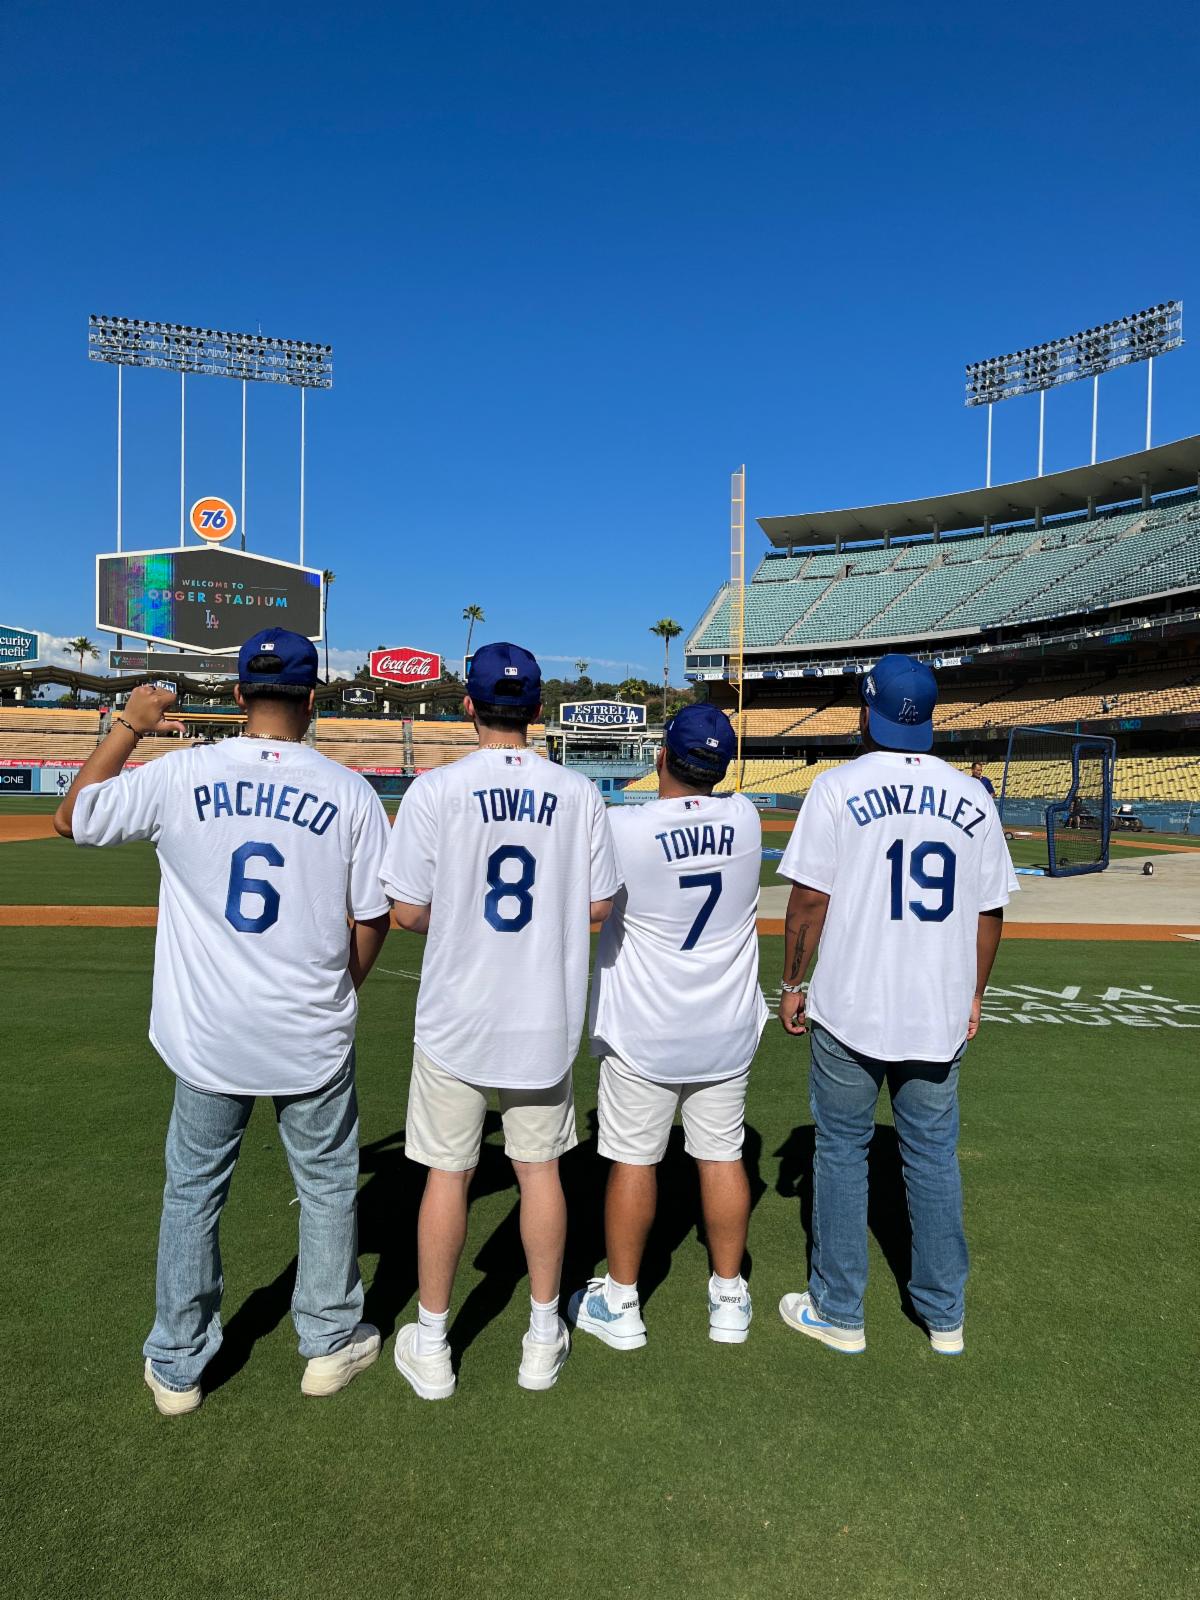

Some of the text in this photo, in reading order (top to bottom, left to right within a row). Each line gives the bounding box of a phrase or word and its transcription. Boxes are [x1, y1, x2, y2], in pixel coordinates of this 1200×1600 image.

[200, 509, 227, 529] 76
[182, 579, 244, 590] WELCOME TO
[214, 592, 288, 608] STADIUM
[0, 647, 26, 657] nefit
[376, 655, 433, 675] Coca-Cola
[568, 713, 623, 724] JALISCO
[193, 781, 339, 836] PACHECO
[472, 787, 558, 827] TOVAR
[846, 785, 986, 839] GONZALEZ
[655, 824, 735, 862] TOVAR
[225, 840, 285, 934] 6
[483, 844, 537, 933] 8
[886, 838, 957, 923] 19
[678, 871, 723, 952] 7
